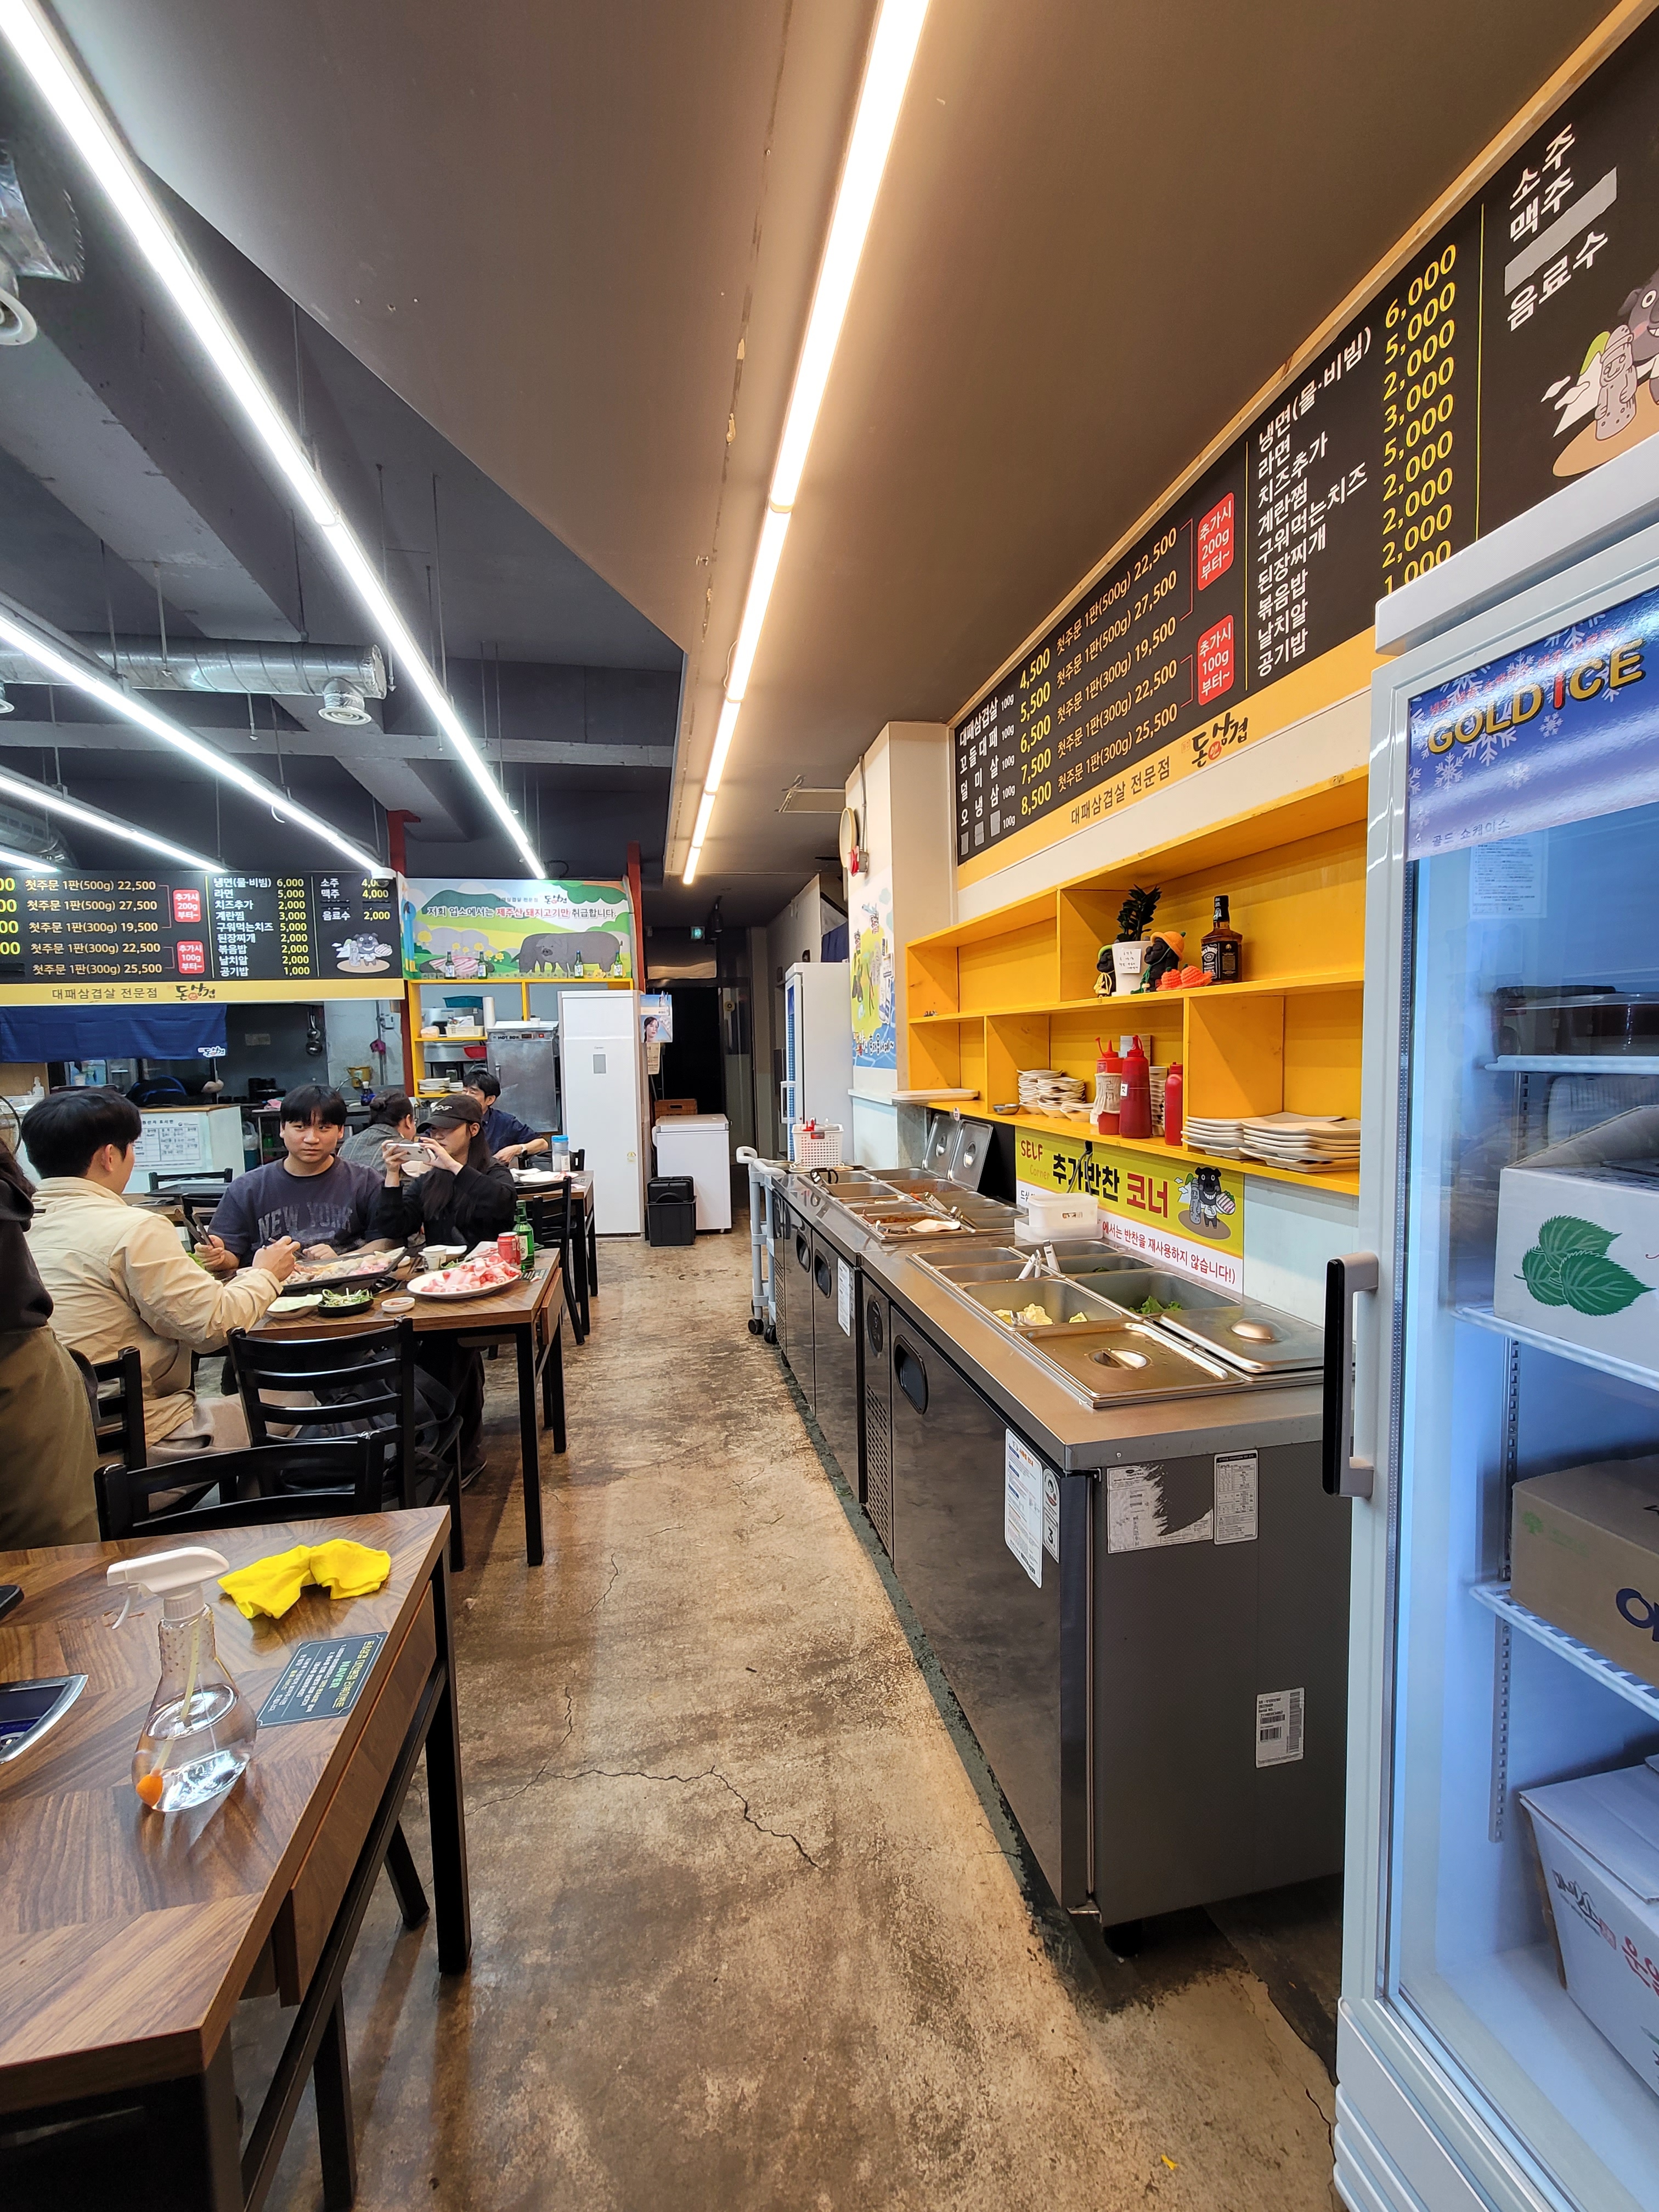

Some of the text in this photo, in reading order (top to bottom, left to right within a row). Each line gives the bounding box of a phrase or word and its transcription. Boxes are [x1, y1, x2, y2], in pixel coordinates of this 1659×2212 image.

[1509, 123, 1576, 210] 소주
[1510, 168, 1574, 242] 맥주
[1385, 244, 1456, 329] 6,000
[1507, 232, 1607, 332] 음료수
[1259, 282, 1455, 479] 라면 5,000
[1258, 319, 1454, 509] 치즈추가 2,000
[1258, 357, 1454, 536] 계란찜 3,000
[1257, 393, 1453, 564] 구워먹는치즈 5,000
[1199, 500, 1232, 541] 추가시
[1257, 431, 1453, 595] 된장찌개 2,000
[1201, 528, 1229, 561] 200g
[1257, 467, 1453, 621] 볶음밥 2,000
[1258, 504, 1452, 651] 날치알 2,000
[1258, 540, 1451, 677] 공기밥 1000
[960, 697, 998, 746] 대패삼겹살
[1001, 694, 1014, 710] 100g
[1020, 647, 1050, 689] 4,500
[1057, 618, 1082, 656] 첫주문
[1134, 527, 1176, 582] 22,500
[1199, 622, 1232, 657] 추가시
[1002, 724, 1014, 741] 100g
[1020, 681, 1050, 723] 5,500
[1057, 653, 1082, 689] 첫주문
[1134, 570, 1176, 621] 27,500
[1201, 649, 1229, 675] 100g
[1002, 755, 1014, 770] 100g
[1020, 715, 1051, 753] 6,500
[1057, 691, 1082, 725] 첫주문
[1135, 617, 1176, 662] 19,500
[1427, 637, 1646, 755] GOLD ICE
[1002, 784, 1015, 800] 100g
[1021, 748, 1051, 785] 7,500
[1057, 727, 1083, 759] 첫주문
[1135, 659, 1177, 703] 22,500
[1003, 815, 1015, 830] 100g
[1021, 781, 1051, 816] 8,500
[1058, 763, 1083, 793] 첫주문
[1136, 703, 1177, 744] 25,500
[1071, 781, 1126, 825] 대패삼겹살
[1131, 756, 1170, 795] 전문점
[25, 879, 59, 891] 첫주문
[117, 881, 156, 891] 22,500
[175, 893, 198, 901] 추가시
[214, 889, 304, 900] 라면 5,000
[276, 878, 304, 888] 6,000
[320, 878, 340, 888] 소주
[320, 889, 388, 899] 맥주 4,000
[27, 900, 61, 911] 첫주문
[119, 901, 157, 912] 27,500
[178, 902, 198, 911] 200g
[215, 900, 306, 911] 치즈추가 2,000
[216, 911, 307, 922] 계란찜 3,000
[322, 911, 391, 921] 음료수 2,000
[428, 907, 447, 917] 저희
[449, 907, 494, 918] 업소에서는
[496, 908, 523, 918] 제주산
[525, 908, 570, 918] 돼지고기만
[29, 922, 63, 933] 첫주문
[121, 922, 159, 934] 19,500
[216, 922, 307, 933] 구워먹는치즈 5,000
[217, 933, 308, 944] 된장찌개 2,000
[31, 943, 64, 955] 첫주문
[122, 943, 161, 954] 22,500
[218, 944, 308, 955] 볶음밥 2,000
[219, 956, 309, 966] 날치알 2,000
[32, 964, 66, 975] 첫주문
[124, 964, 162, 975] 25,500
[219, 967, 311, 977] 공기밥 1,000
[52, 988, 115, 1000] 대패삼겹살
[121, 987, 157, 999] 전문점
[1021, 1139, 1043, 1162] SELF
[1030, 1164, 1050, 1180] Corner
[1127, 1172, 1169, 1219] 코너
[258, 1206, 300, 1244] NEW
[1124, 1228, 1146, 1249] 반찬을
[1148, 1237, 1188, 1267] 재사용하지
[1190, 1254, 1235, 1285] 않습니다!)
[329, 1660, 351, 1689] NAVER
